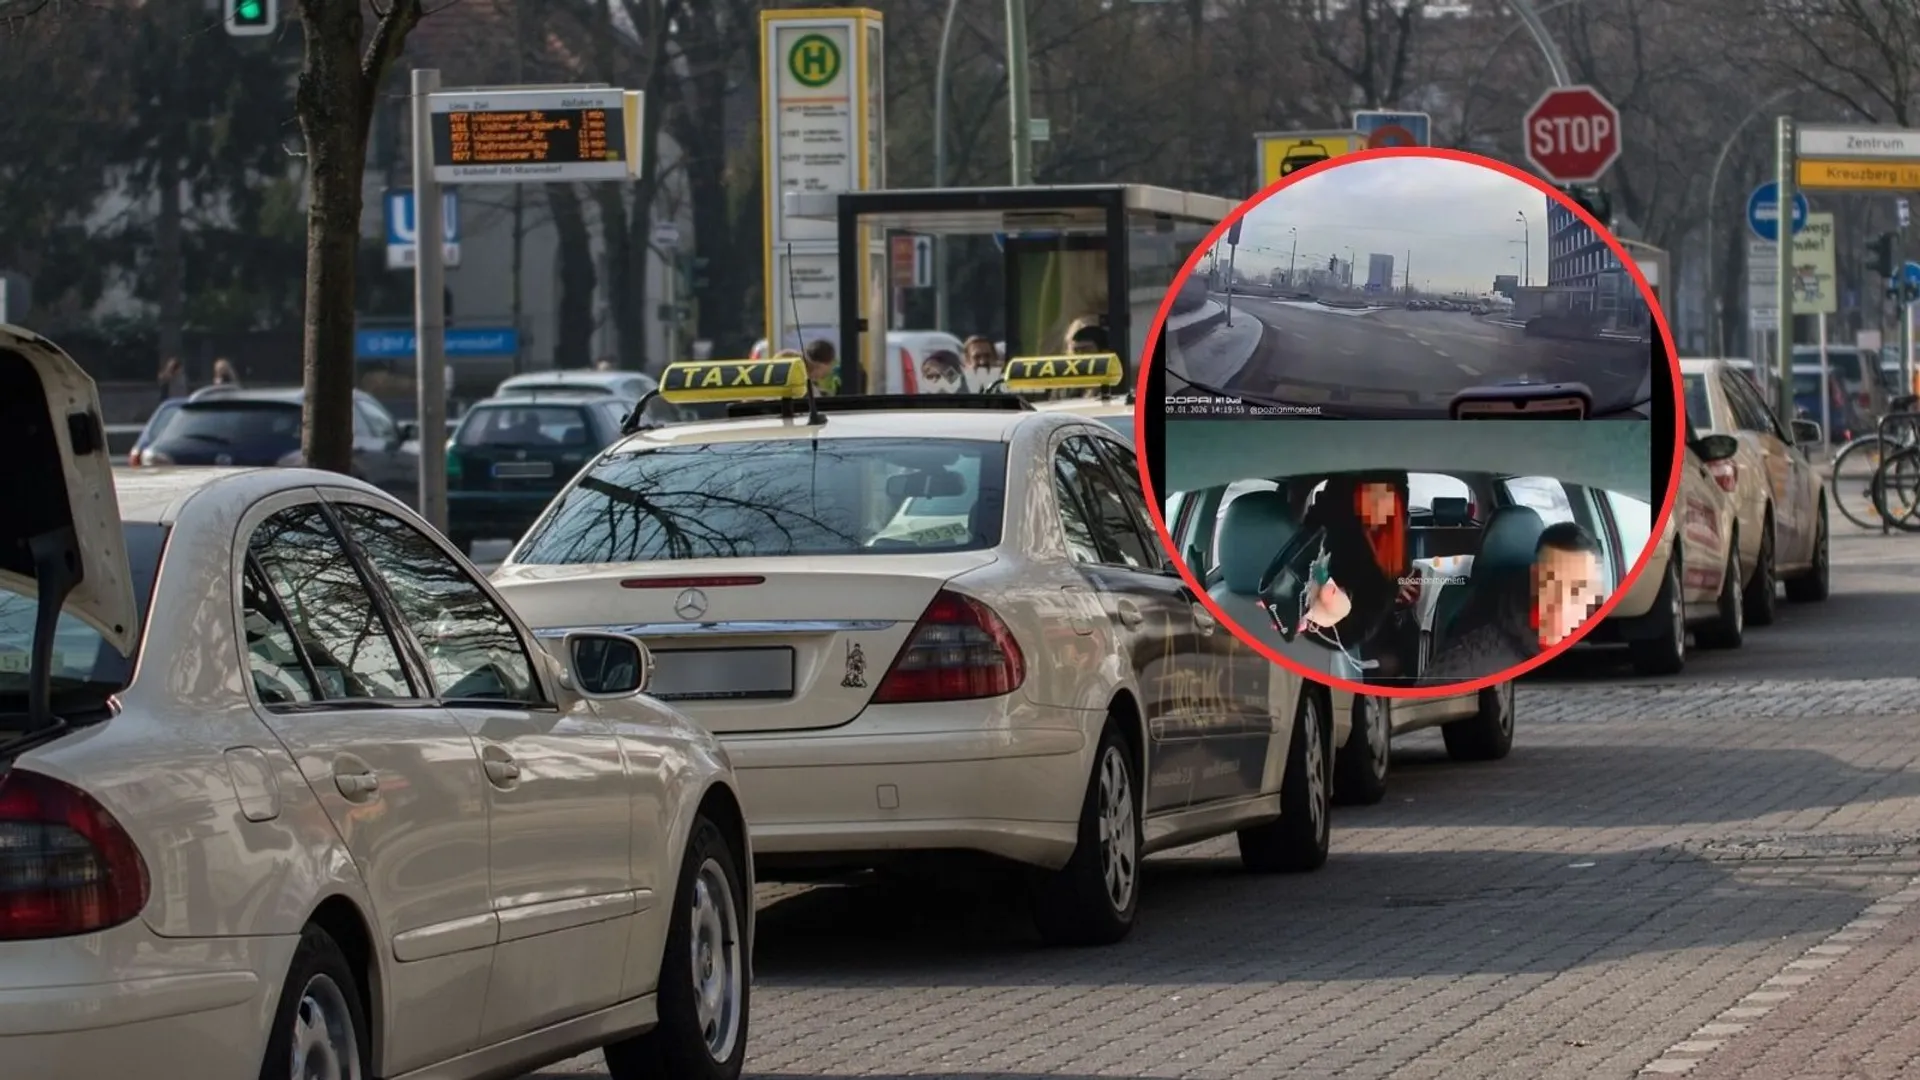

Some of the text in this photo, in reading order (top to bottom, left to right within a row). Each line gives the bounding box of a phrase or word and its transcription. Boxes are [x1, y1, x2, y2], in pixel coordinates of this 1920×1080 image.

[803, 47, 827, 75] H
[1535, 115, 1610, 155] STOP
[1847, 136, 1904, 149] Zentrum
[1826, 166, 1898, 184] Kreuzberg
[683, 364, 775, 388] TAXI
[1023, 358, 1096, 378] TAXI
